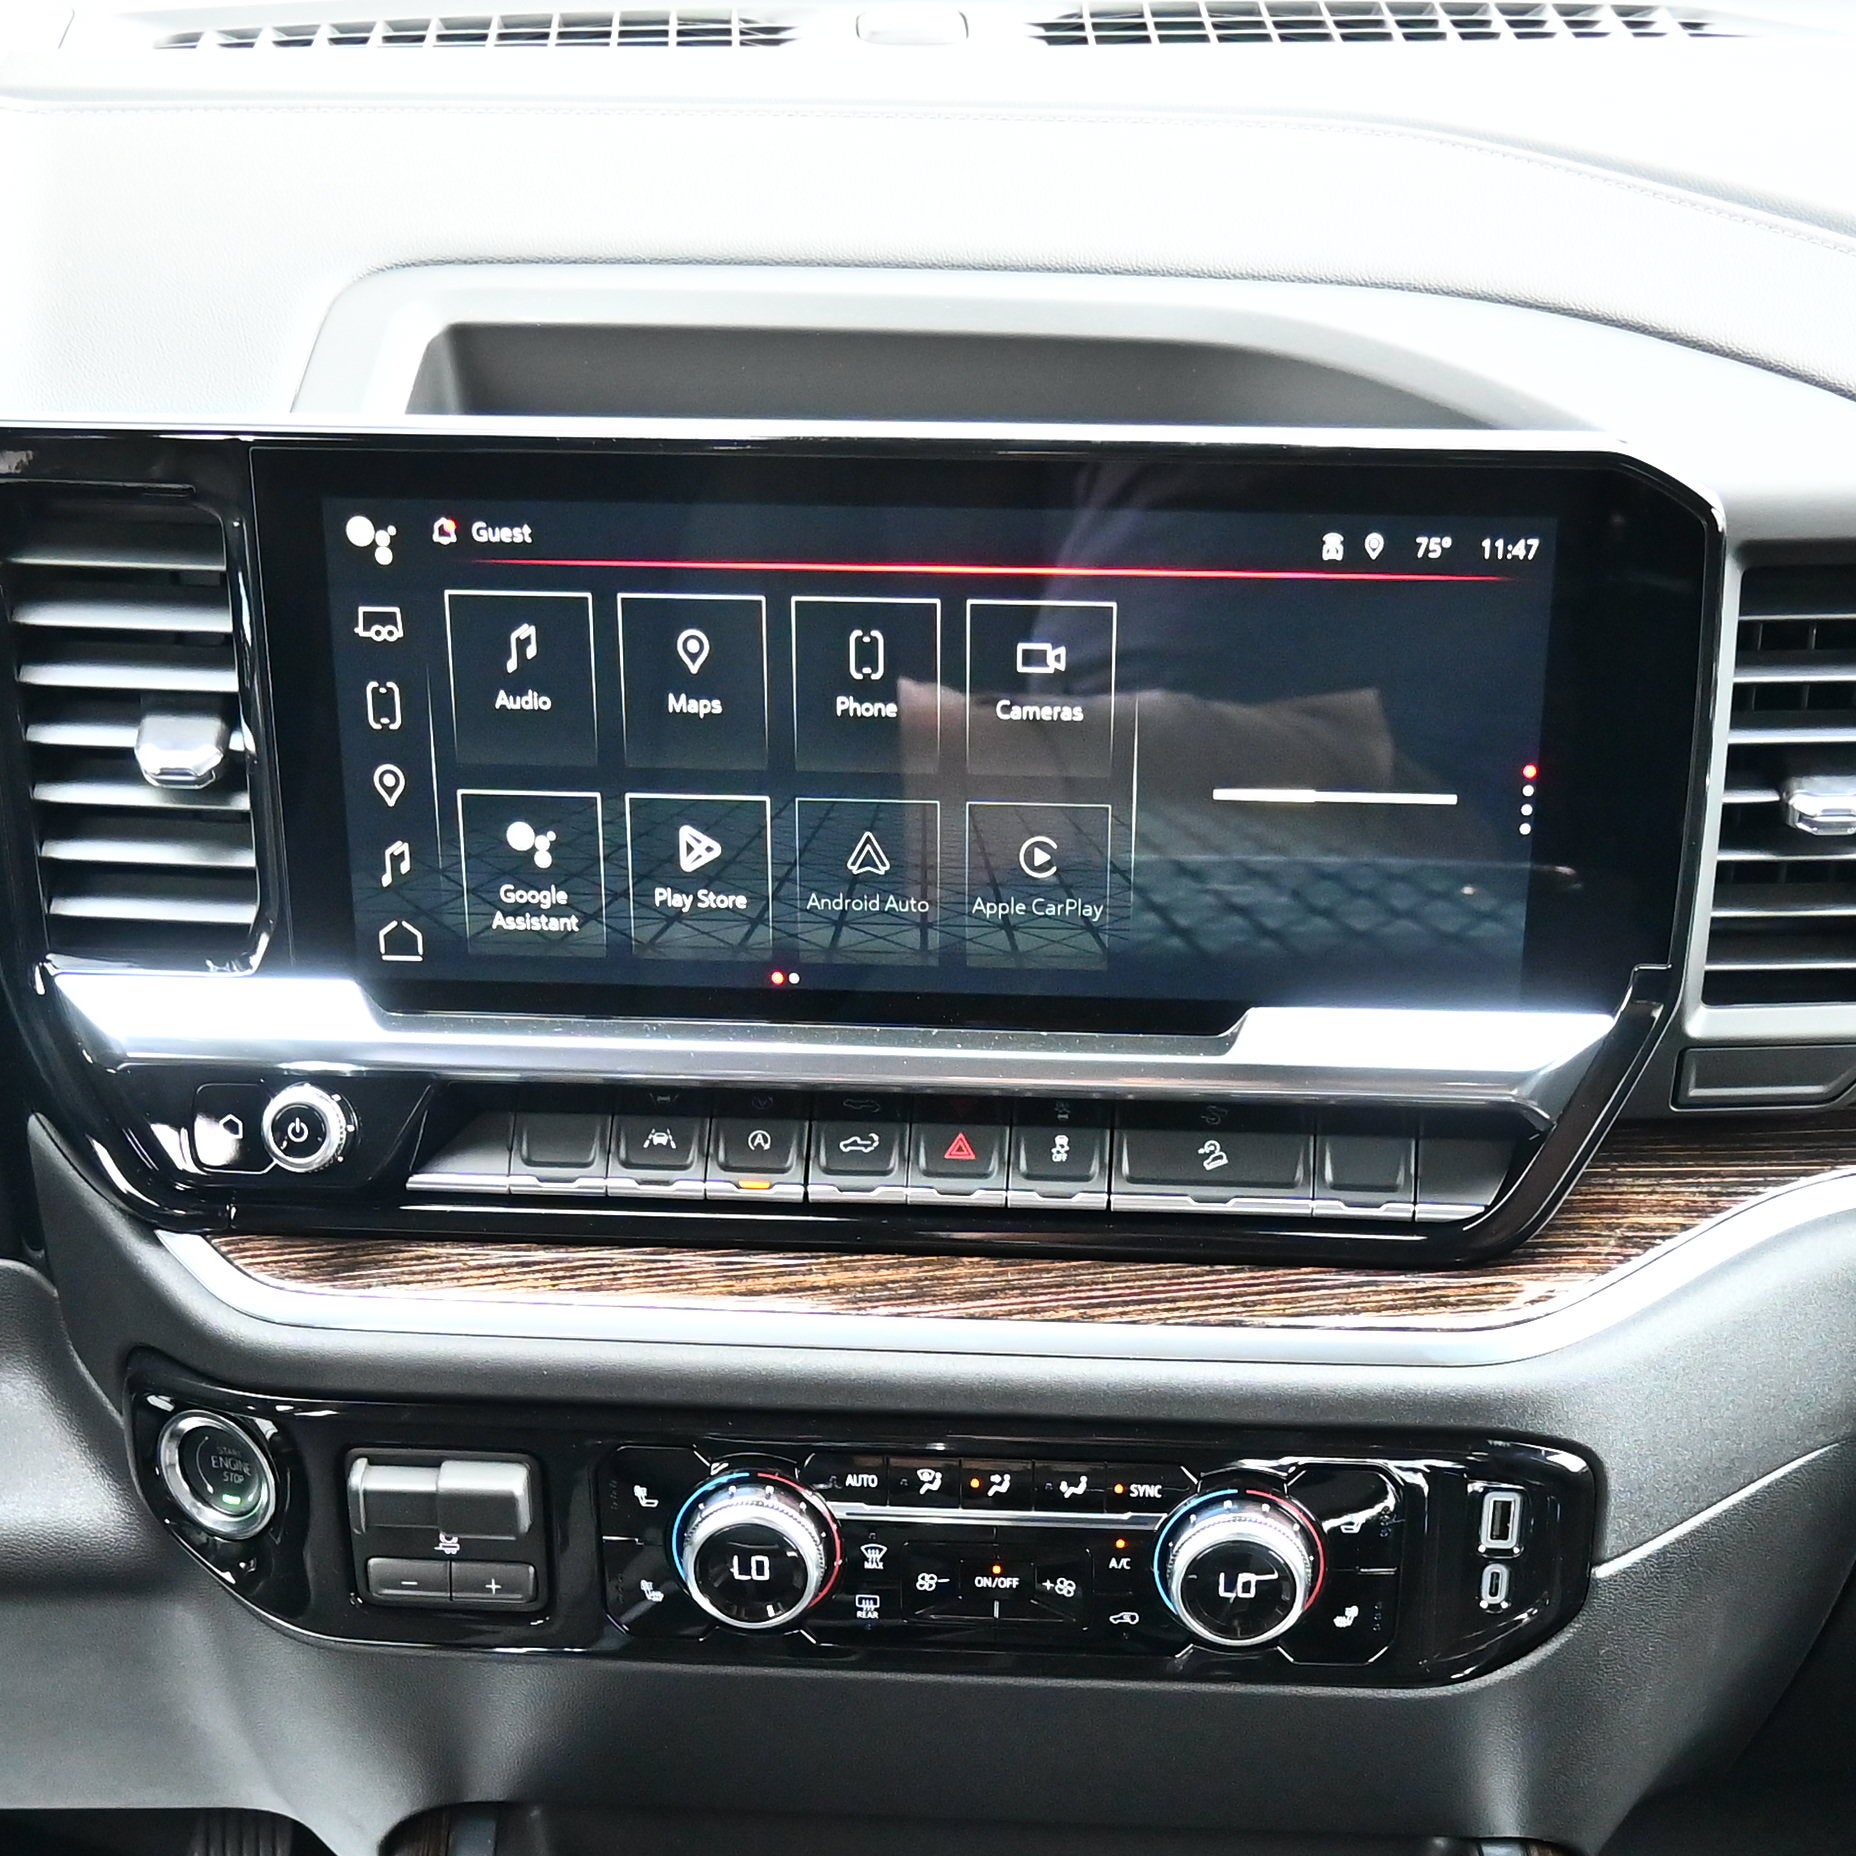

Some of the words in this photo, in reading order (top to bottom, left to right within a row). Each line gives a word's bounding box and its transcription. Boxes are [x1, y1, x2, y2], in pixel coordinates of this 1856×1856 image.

[471, 522, 532, 545] Guest
[1481, 538, 1540, 560] 11:47
[495, 689, 552, 711] Audio
[667, 694, 722, 718] Maps
[835, 697, 898, 718] Phone
[995, 700, 1084, 722] Cameras
[499, 884, 568, 909] Google
[654, 888, 692, 912] Play
[697, 889, 747, 909] Store
[806, 894, 882, 914] Android
[887, 895, 929, 914] Auto
[972, 897, 1026, 919] Apple
[1031, 898, 1104, 922] CarPlay
[492, 912, 579, 932] Assistant
[211, 1455, 251, 1476] ENGINE
[223, 1471, 245, 1484] STOP
[845, 1473, 878, 1488] AUTO
[1129, 1483, 1163, 1499] SYNC
[732, 1554, 770, 1581] LO
[1109, 1557, 1132, 1570] A/C
[975, 1576, 1019, 1589] ON/OFF
[1217, 1572, 1256, 1599] LO
[856, 1610, 879, 1620] REAR
